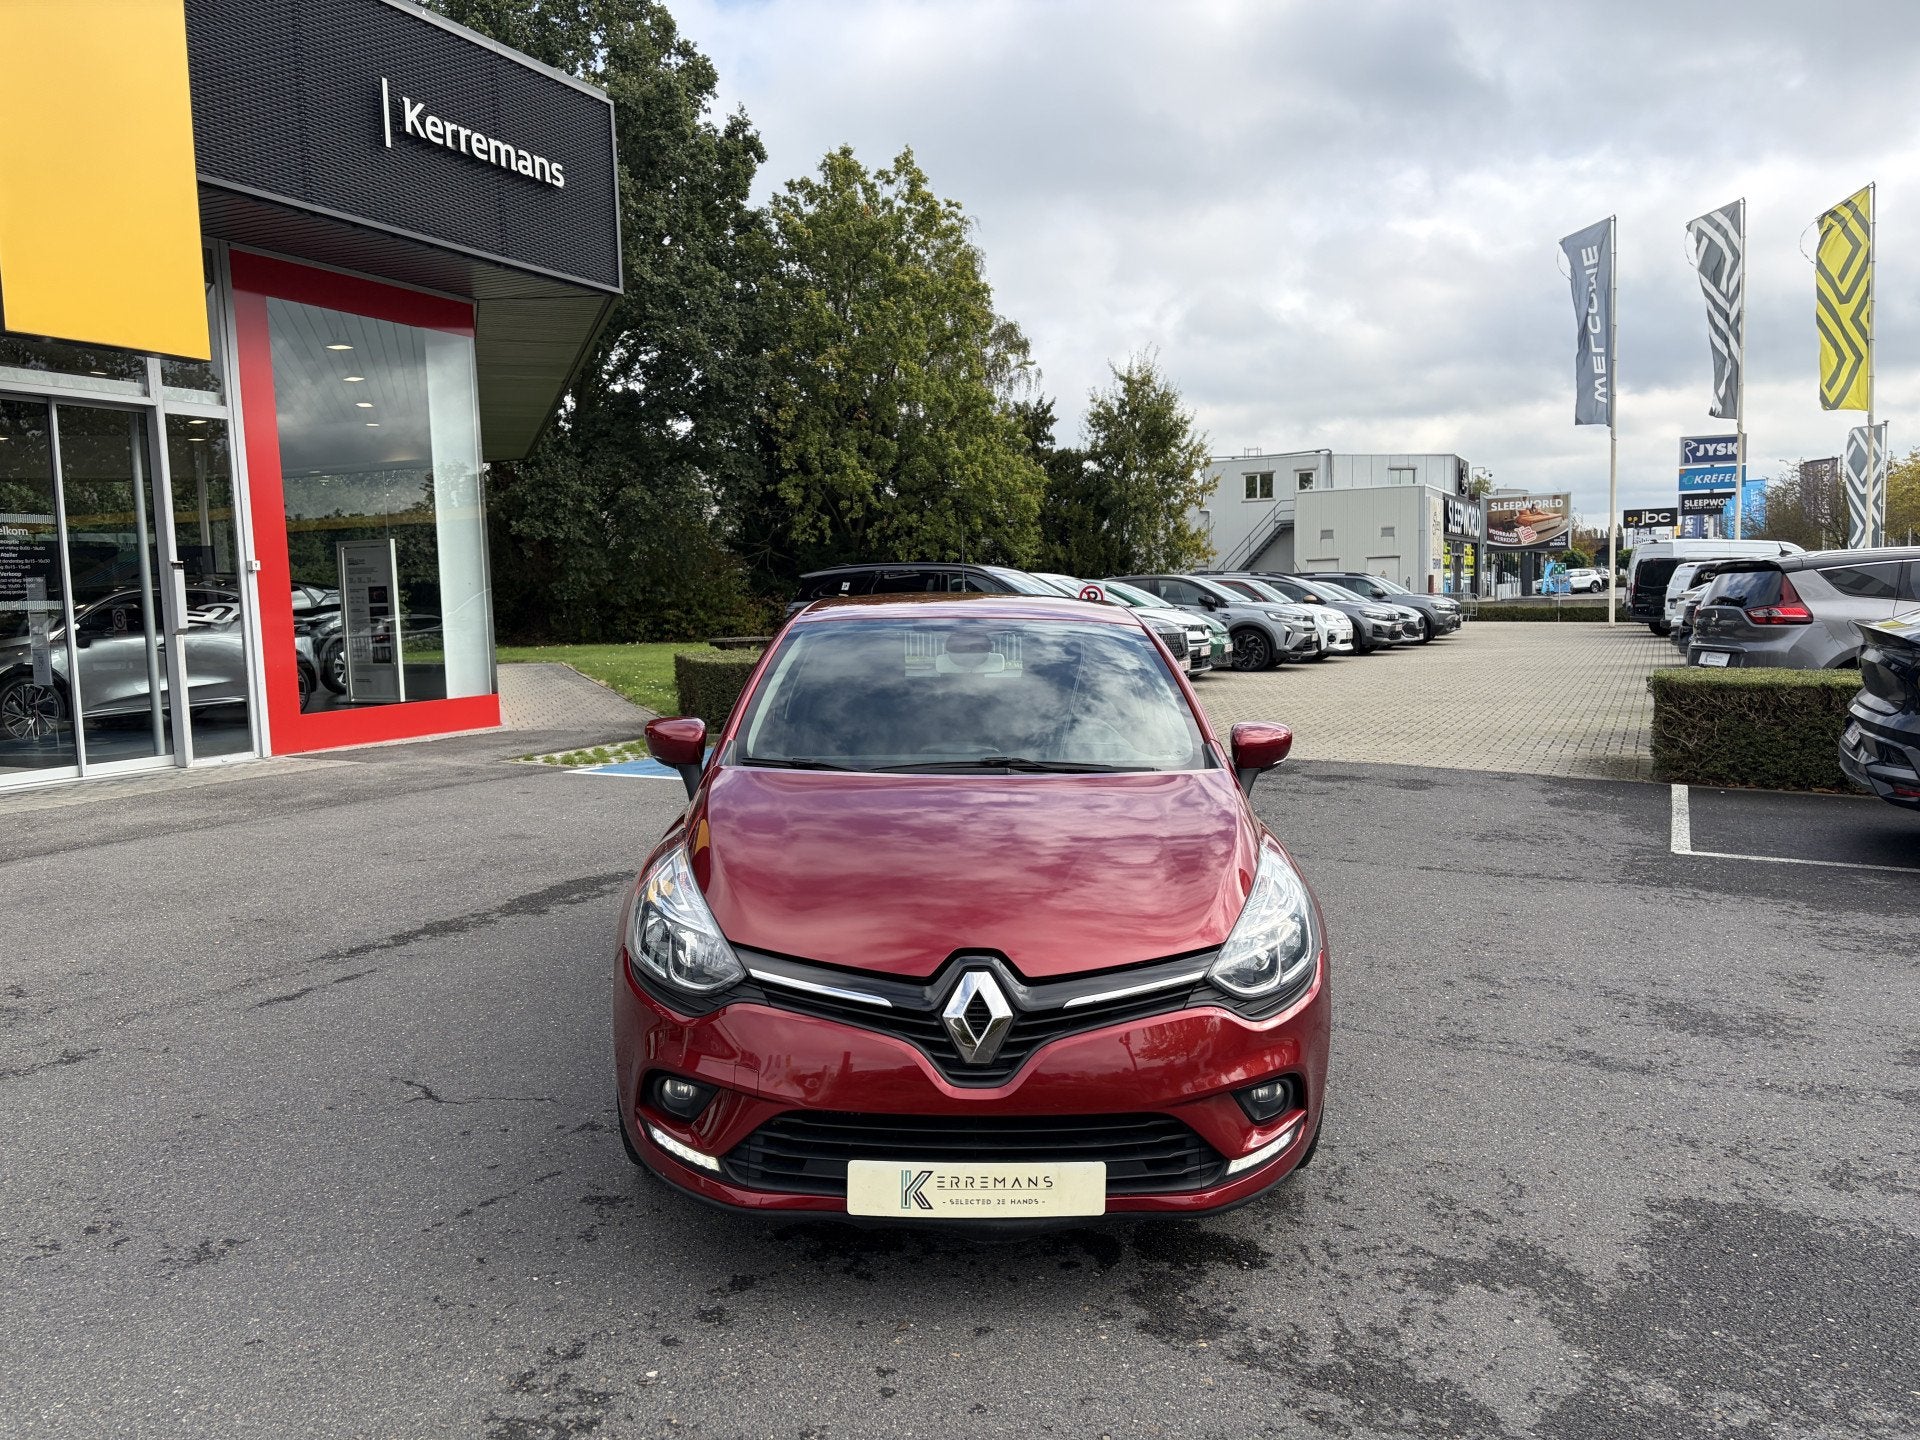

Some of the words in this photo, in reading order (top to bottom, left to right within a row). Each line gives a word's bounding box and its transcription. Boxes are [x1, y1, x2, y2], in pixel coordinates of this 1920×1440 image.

[402, 97, 565, 188] Kerremans
[1696, 443, 1737, 456] JYSK
[1491, 499, 1564, 511] SLEEPWORLD
[1684, 498, 1728, 507] SLEEPWO
[1639, 511, 1671, 526] jbc
[901, 1170, 1053, 1209] KERREMANS
